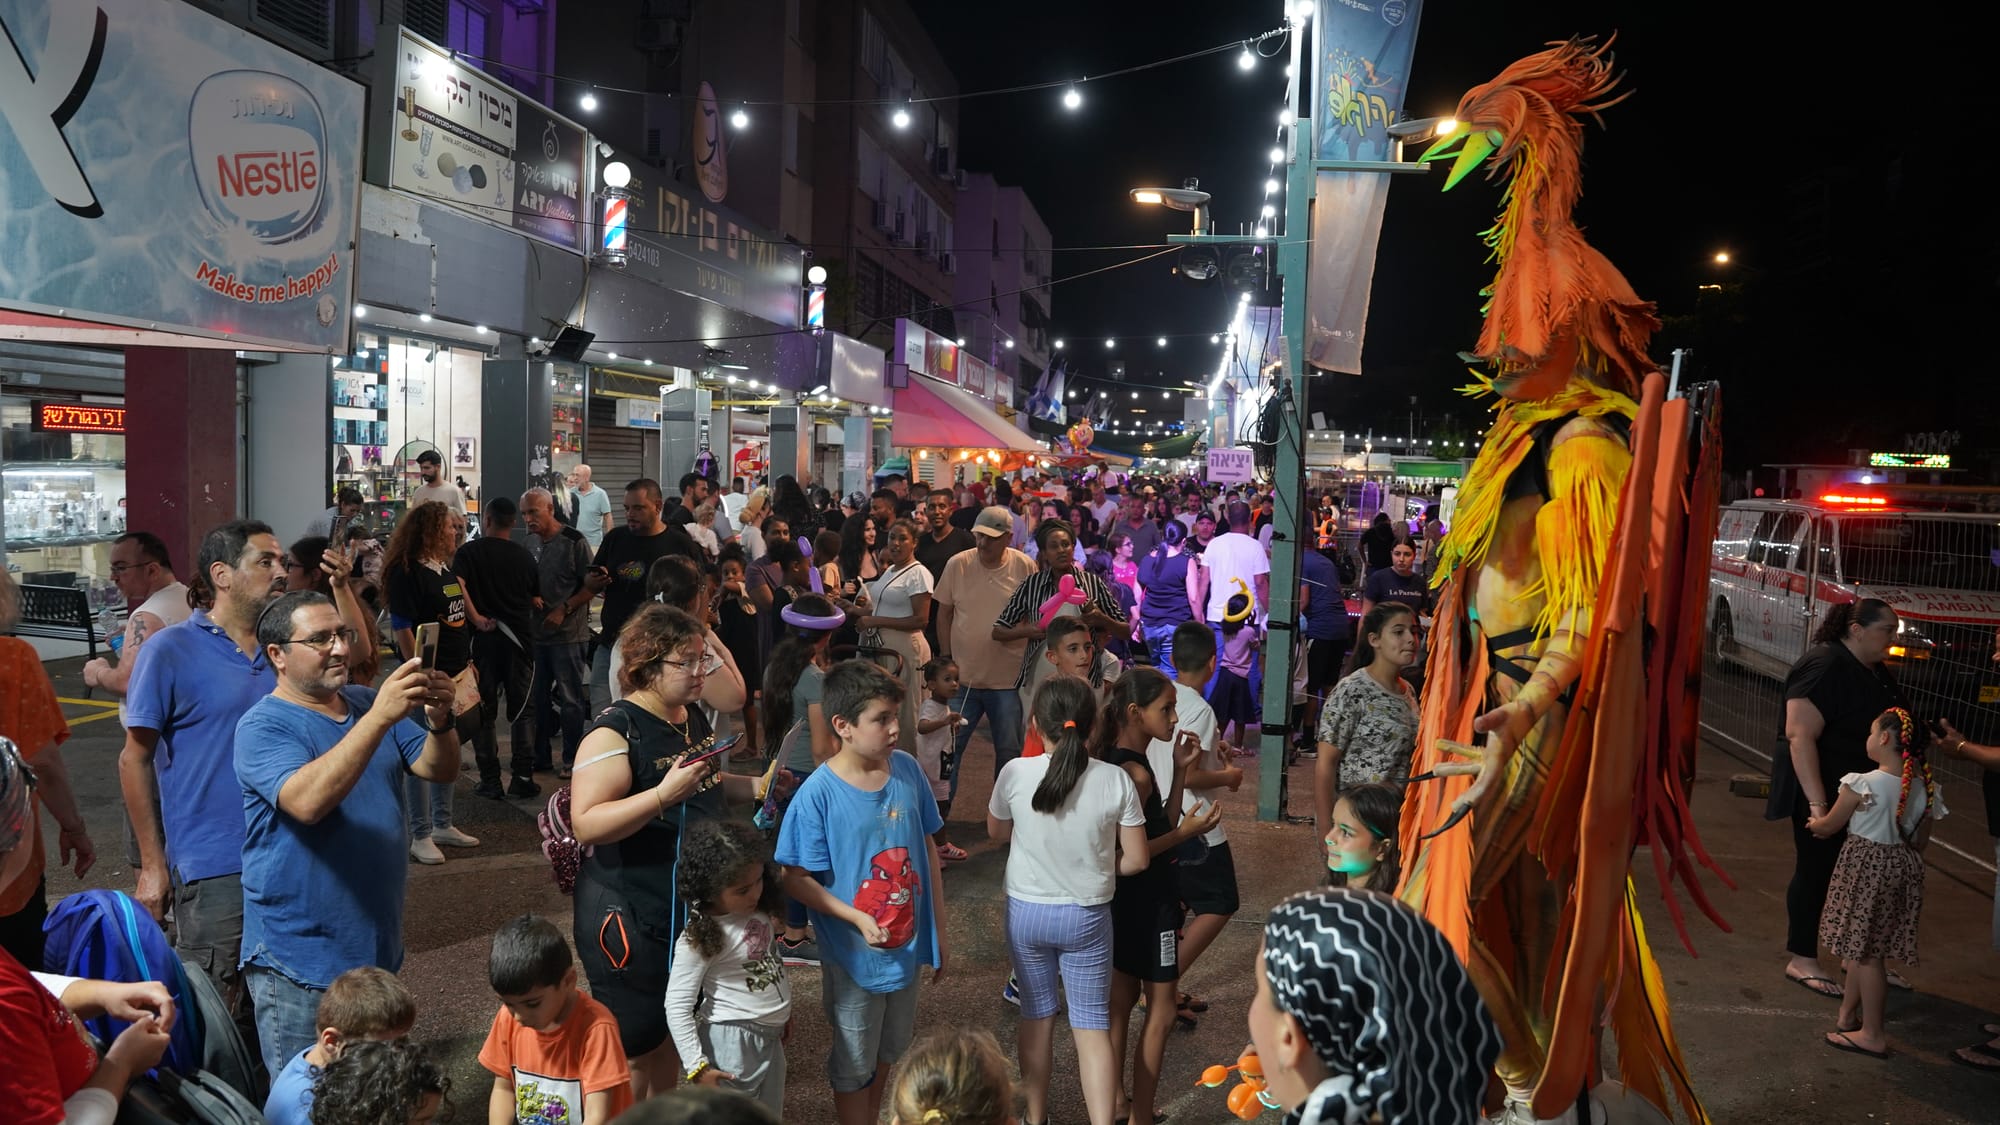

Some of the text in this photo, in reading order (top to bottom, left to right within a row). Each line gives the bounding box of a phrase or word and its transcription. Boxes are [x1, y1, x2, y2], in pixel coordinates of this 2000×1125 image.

[407, 52, 513, 129] מכון הקש
[217, 150, 317, 198] Nestlé
[552, 172, 577, 199] ארט
[520, 187, 545, 213] ART
[545, 199, 576, 224] Judaica
[658, 186, 718, 252] בן-זקן
[628, 240, 660, 267] 6424103
[196, 253, 339, 302] Makes me happy!
[66, 407, 101, 425] בגורל
[1210, 453, 1250, 469] יציאה
